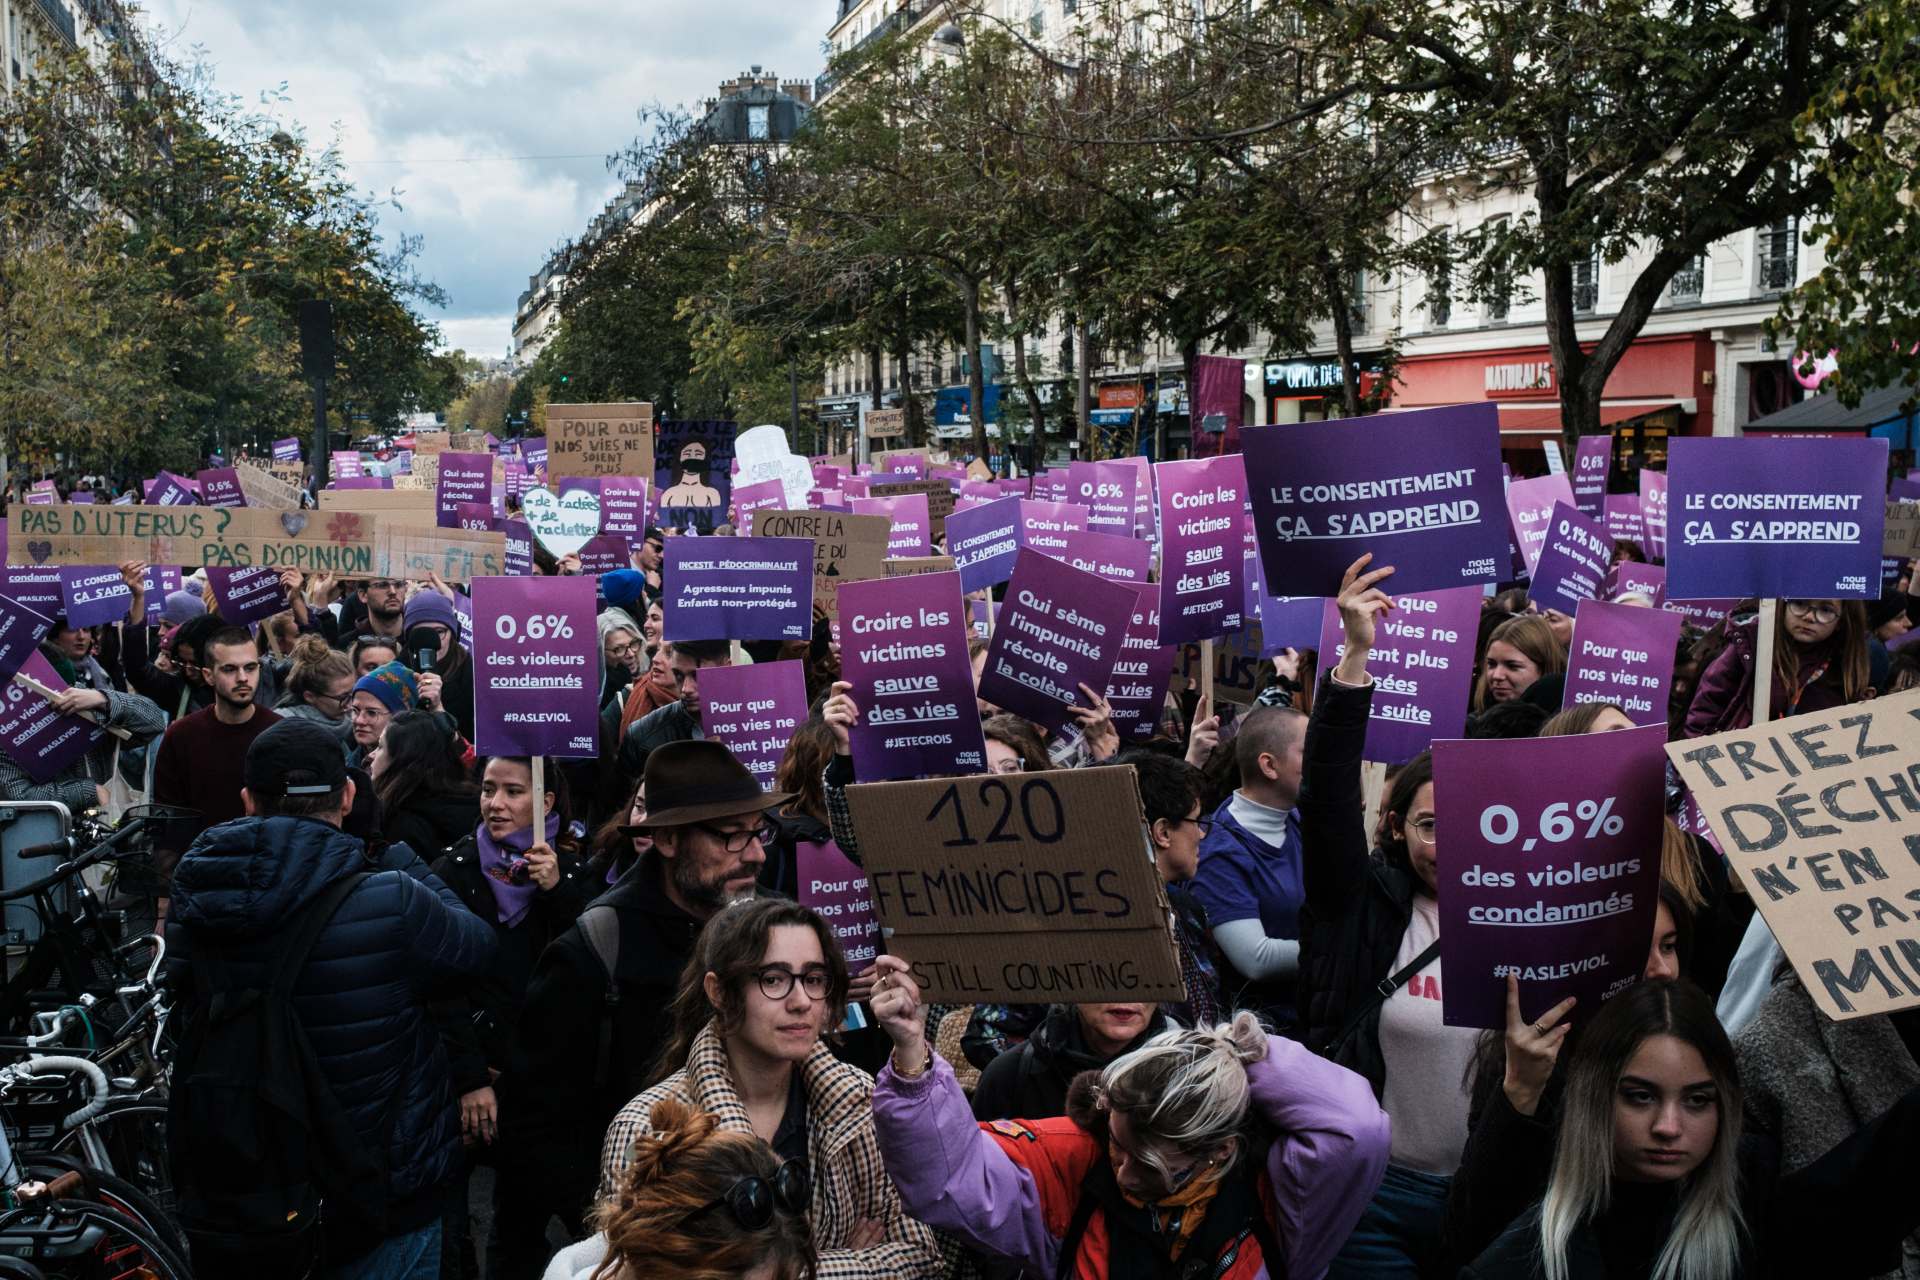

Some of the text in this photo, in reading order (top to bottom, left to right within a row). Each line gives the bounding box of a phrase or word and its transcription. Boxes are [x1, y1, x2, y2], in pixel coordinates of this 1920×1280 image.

[1287, 365, 1319, 388] OPTIC
[563, 420, 648, 437] POUR QUE
[554, 439, 582, 453] NOS
[624, 439, 639, 450] NE
[583, 452, 624, 463] SOIENT
[1581, 455, 1604, 471] 0,6%
[594, 464, 622, 474] PLUS
[208, 480, 233, 493] 0,6%
[443, 481, 485, 489] l'impunité
[604, 488, 641, 497] Croire les
[1080, 483, 1124, 499] 0,6%
[1271, 468, 1476, 504] LE CONSENTEMENT
[443, 492, 473, 500] récolte
[534, 496, 551, 508] de
[606, 499, 637, 508] victimes
[1171, 486, 1237, 510] Croire les
[1685, 494, 1862, 511] LE CONSENTEMENT
[541, 511, 558, 522] de
[610, 512, 633, 520] sauve
[1093, 503, 1128, 513] violeurs
[1609, 511, 1628, 519] Pour
[21, 509, 61, 535] PAS
[73, 508, 204, 539] D'UTERUS
[605, 522, 637, 531] des vies
[1025, 518, 1060, 532] Croire
[1178, 514, 1231, 537] victimes
[1275, 516, 1313, 542] ÇA
[1327, 500, 1481, 539] S'APPREND
[1518, 512, 1538, 524] Qui
[536, 524, 598, 537] raclettes
[763, 516, 844, 538] CONTRE LA
[1684, 521, 1715, 545] ÇA
[1730, 521, 1861, 544] S'APPREND
[954, 525, 1015, 551] LE CONSENTEMENT
[1559, 519, 1603, 556] 0,1% DU
[203, 543, 371, 573] PAS D'OPINION
[831, 544, 847, 559] DU
[955, 539, 1017, 569] ÇA S'APPREND
[1185, 543, 1223, 566] sauve
[719, 560, 798, 572] PÉDOCRIMINALITÉ
[1072, 558, 1136, 578] Qui sème
[1461, 564, 1496, 578] toutes
[1468, 557, 1496, 568] nous
[72, 580, 82, 588] LE
[227, 574, 279, 600] des vies
[1176, 568, 1231, 595] des vies
[1626, 580, 1655, 594] Croire
[1835, 580, 1867, 591] toutes
[1843, 575, 1867, 584] nous
[684, 583, 792, 595] Agresseurs impunis
[678, 598, 797, 609] Enfants non-protégés
[1182, 599, 1225, 616] #JETECROIS
[1398, 596, 1438, 615] que
[1662, 601, 1724, 620] Croire les
[852, 608, 950, 634] Croire les
[1018, 590, 1106, 637] Qui sème
[495, 614, 574, 644] 0,6%
[1009, 611, 1102, 661] l'impunité
[1384, 620, 1458, 644] vies ne
[486, 651, 585, 666] des violeurs
[859, 641, 946, 664] victimes
[1003, 638, 1069, 675] récolte
[1405, 649, 1449, 669] plus
[1583, 640, 1649, 665] Pour que
[995, 657, 1014, 677] la
[490, 673, 584, 689] condamnés
[874, 674, 940, 697] sauve
[1578, 668, 1660, 689] nos vies ne
[1121, 682, 1153, 699] vies
[710, 699, 776, 715] Pour que
[1624, 694, 1652, 712] plus
[503, 712, 571, 723] #RASLEVIOL
[867, 700, 960, 727] des vies
[1381, 702, 1432, 726] suite
[713, 717, 795, 734] nos vies ne
[569, 740, 593, 749] toutes
[885, 734, 953, 749] #JETECROIS
[959, 750, 980, 759] nous
[1682, 712, 1899, 789] TRIEZ
[955, 756, 981, 766] toutes
[924, 777, 1066, 848] 120
[1479, 796, 1625, 852] 0,6%
[1461, 858, 1641, 888] des violeurs
[1752, 846, 1890, 901] N'EN
[811, 880, 849, 894] Pour
[813, 898, 870, 916] nos vies
[1468, 891, 1634, 928] condamnés
[1493, 953, 1610, 982] #RASLEVIOL
[1609, 974, 1637, 990] nous
